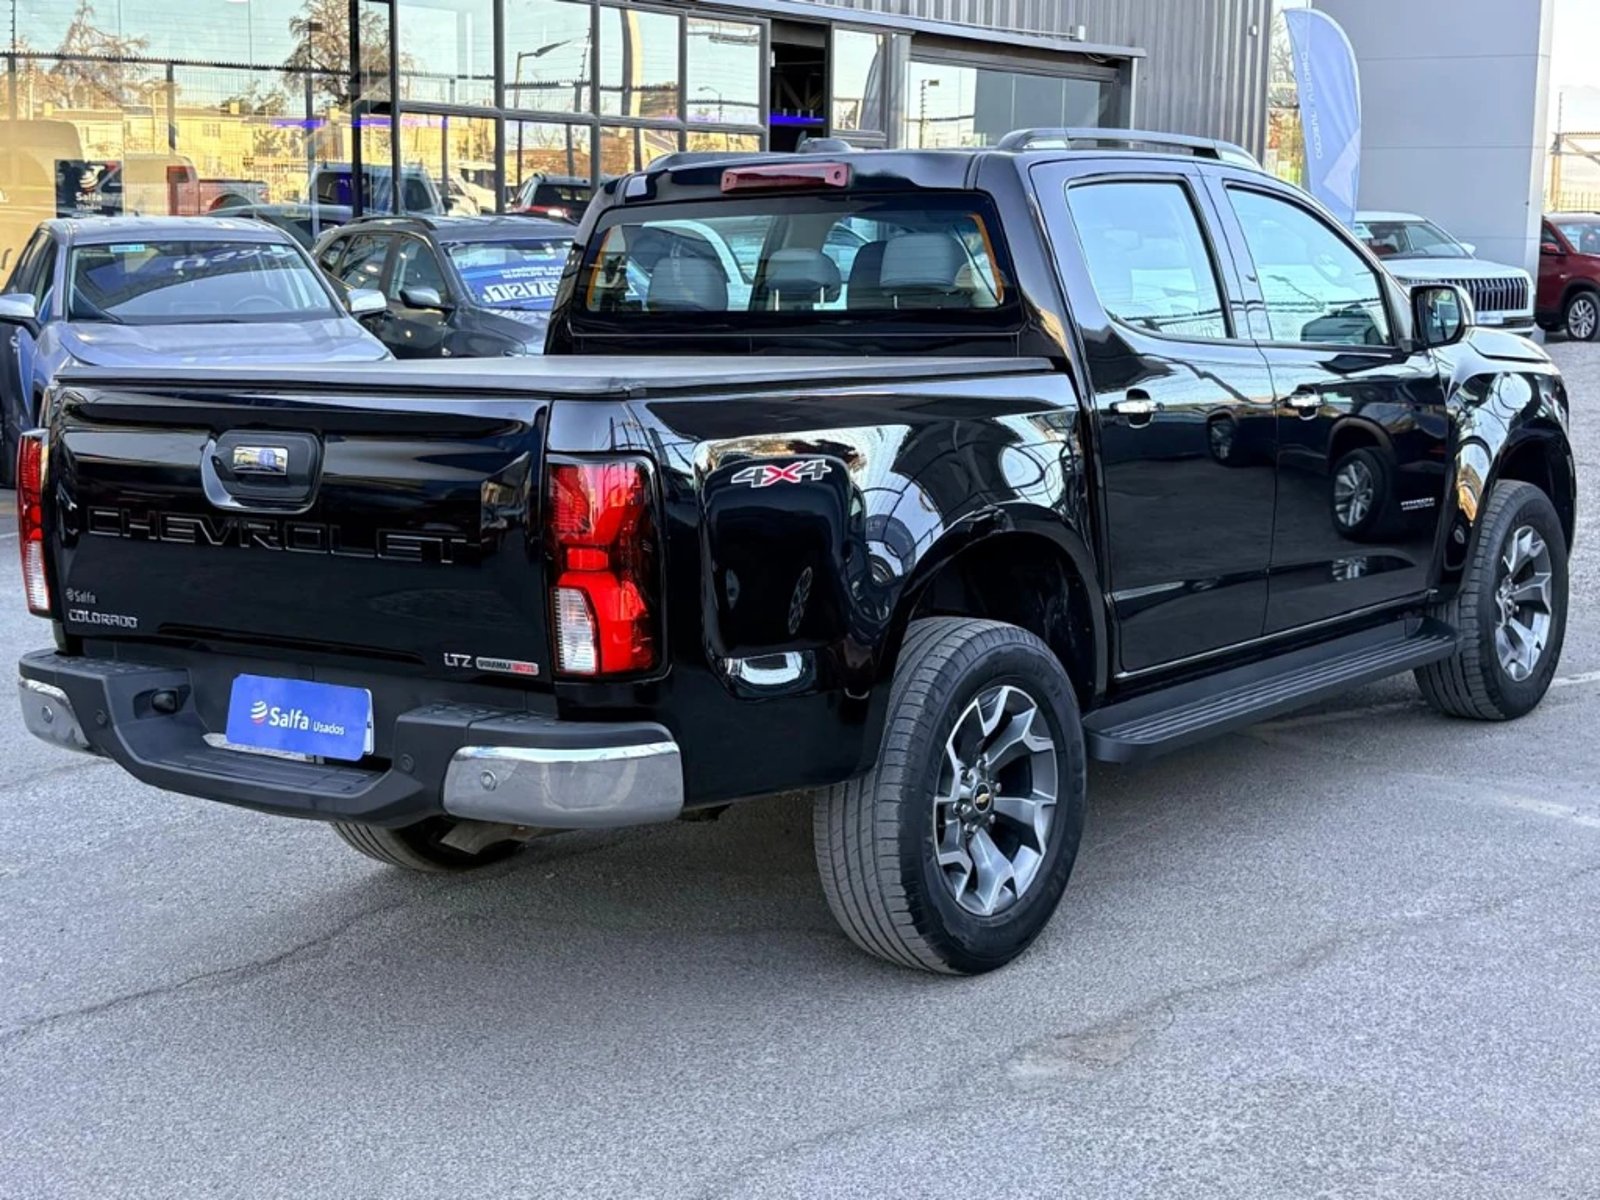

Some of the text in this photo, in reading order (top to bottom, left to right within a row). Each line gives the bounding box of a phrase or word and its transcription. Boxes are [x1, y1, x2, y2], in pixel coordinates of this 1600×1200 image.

[87, 506, 467, 564] CHEVROLET
[74, 590, 96, 604] Salfa
[68, 608, 138, 628] COLORADO
[443, 652, 472, 668] LTZ
[269, 706, 345, 736] Salfa Usados
